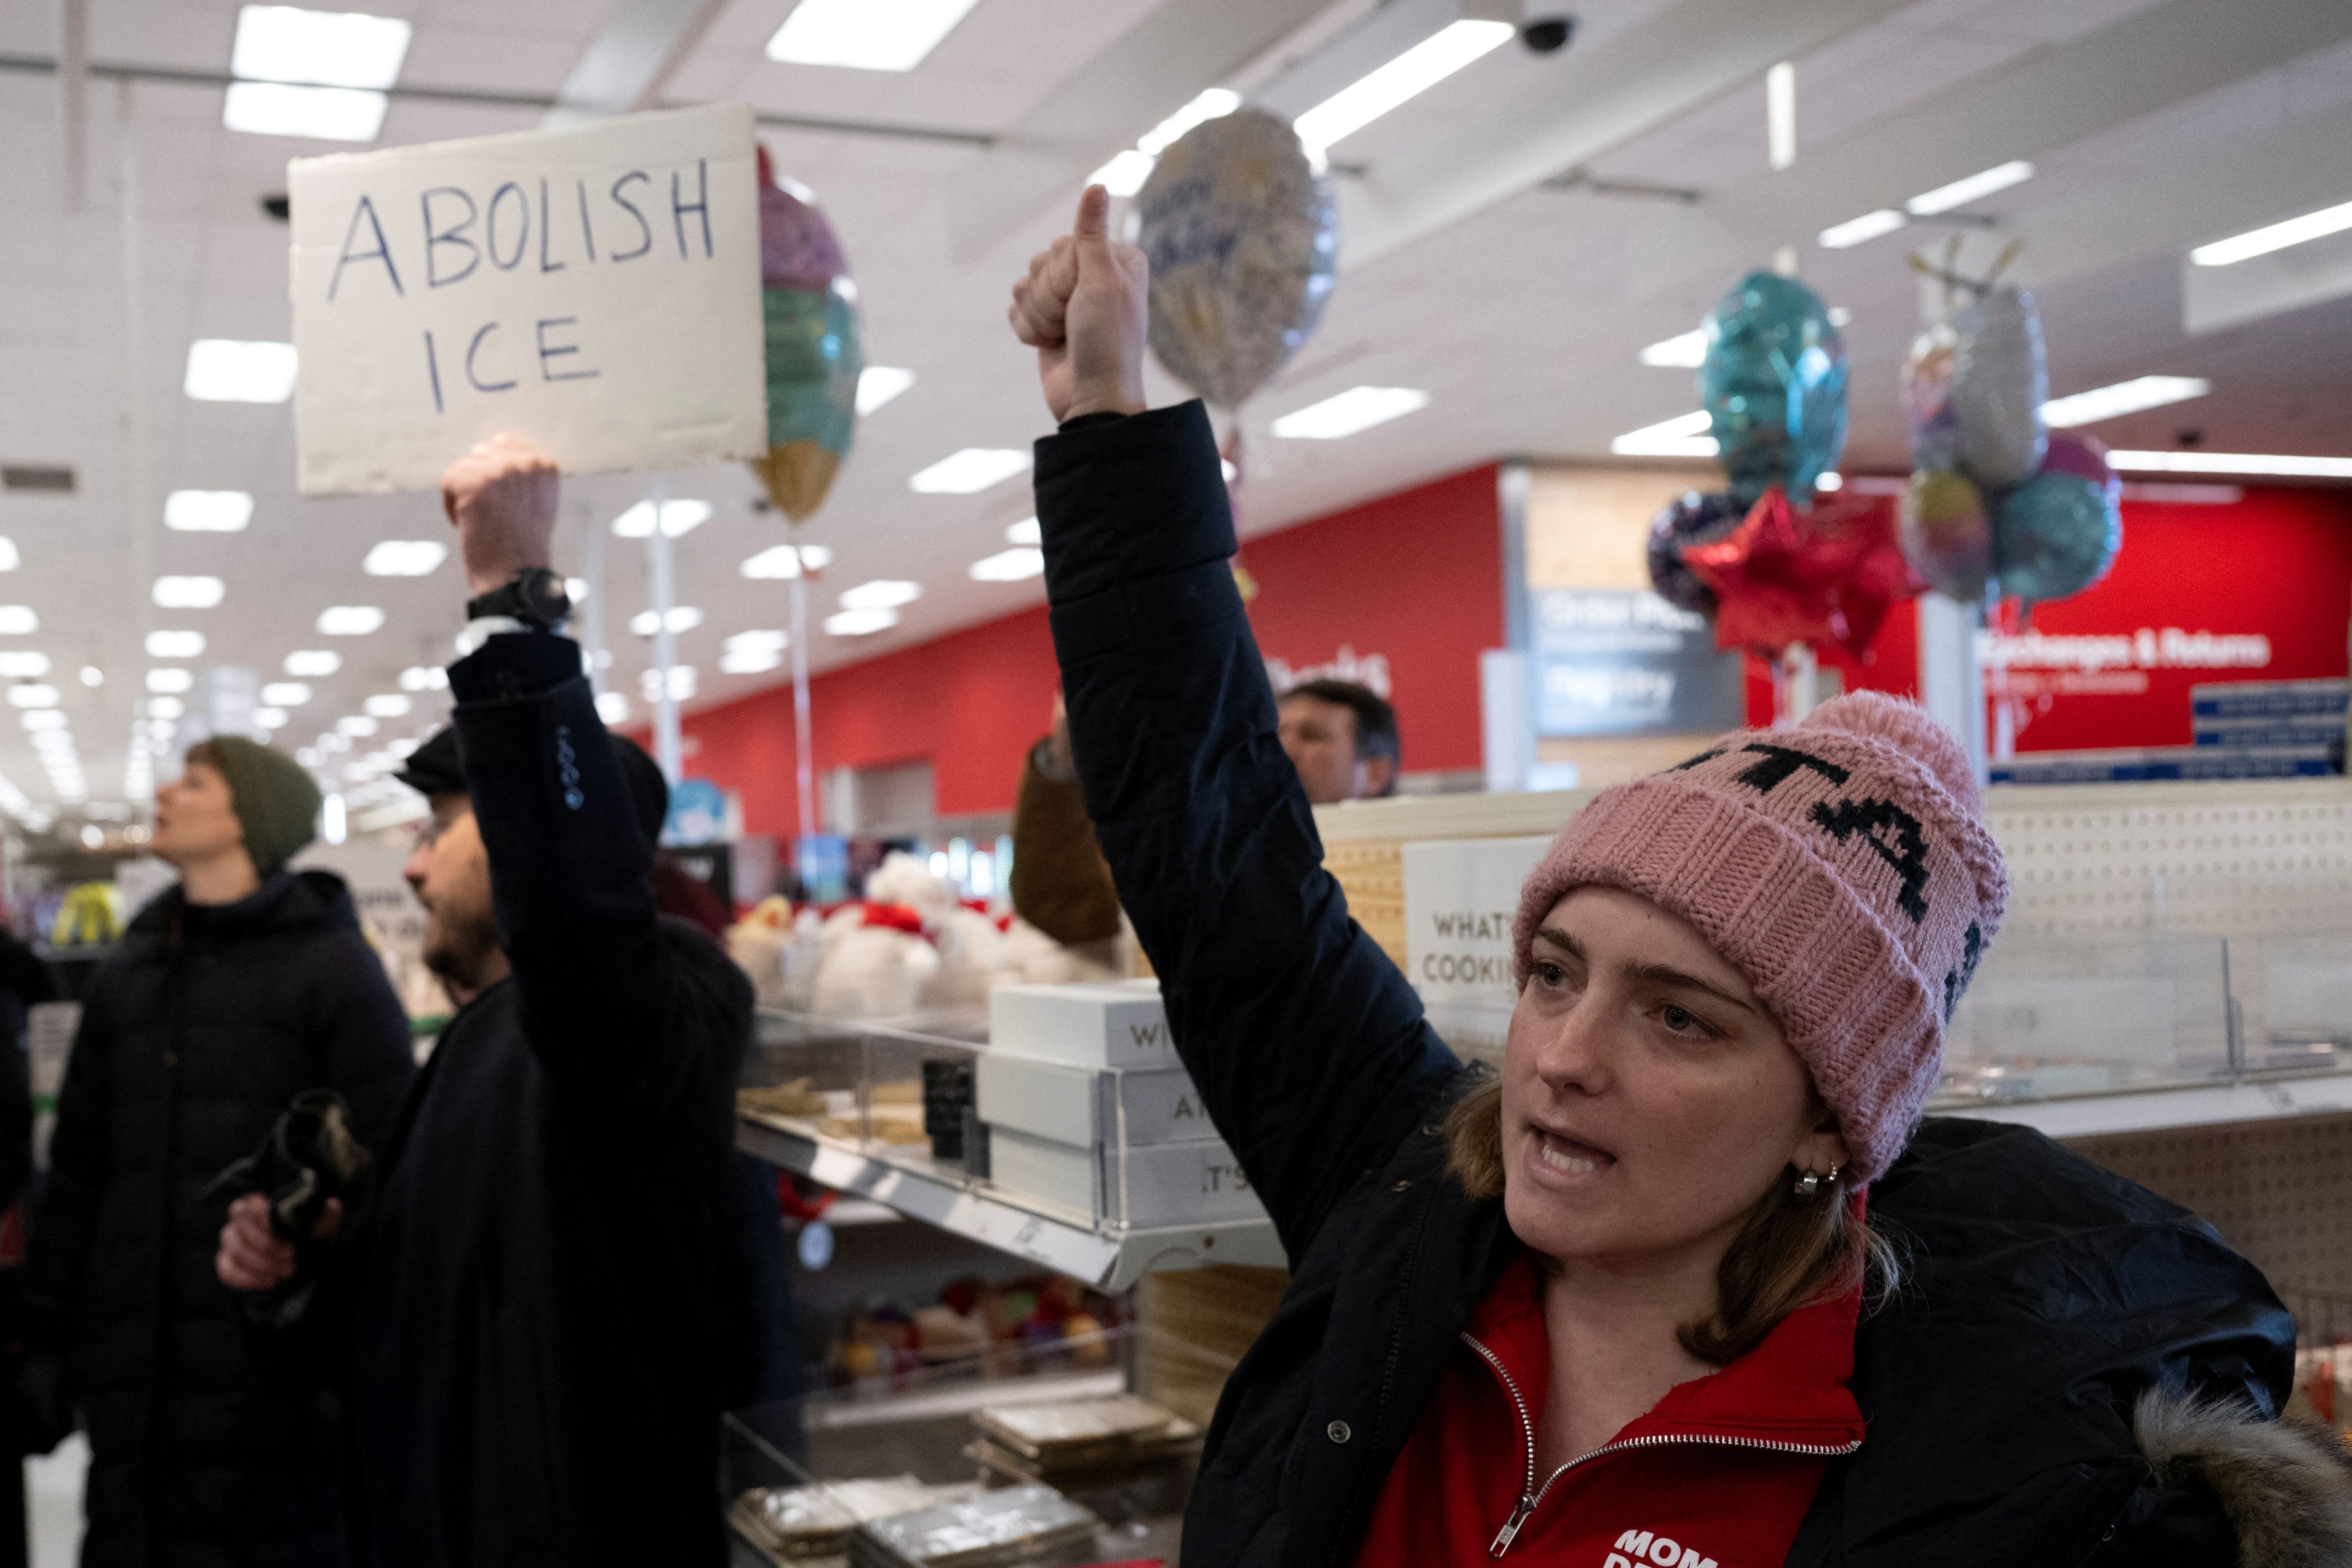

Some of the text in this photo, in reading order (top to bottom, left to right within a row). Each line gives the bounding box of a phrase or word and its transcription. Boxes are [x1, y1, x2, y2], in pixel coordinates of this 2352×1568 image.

[328, 159, 713, 302] ABOLISH
[424, 317, 600, 415] ICE
[1614, 1529, 1718, 1568] MOM
